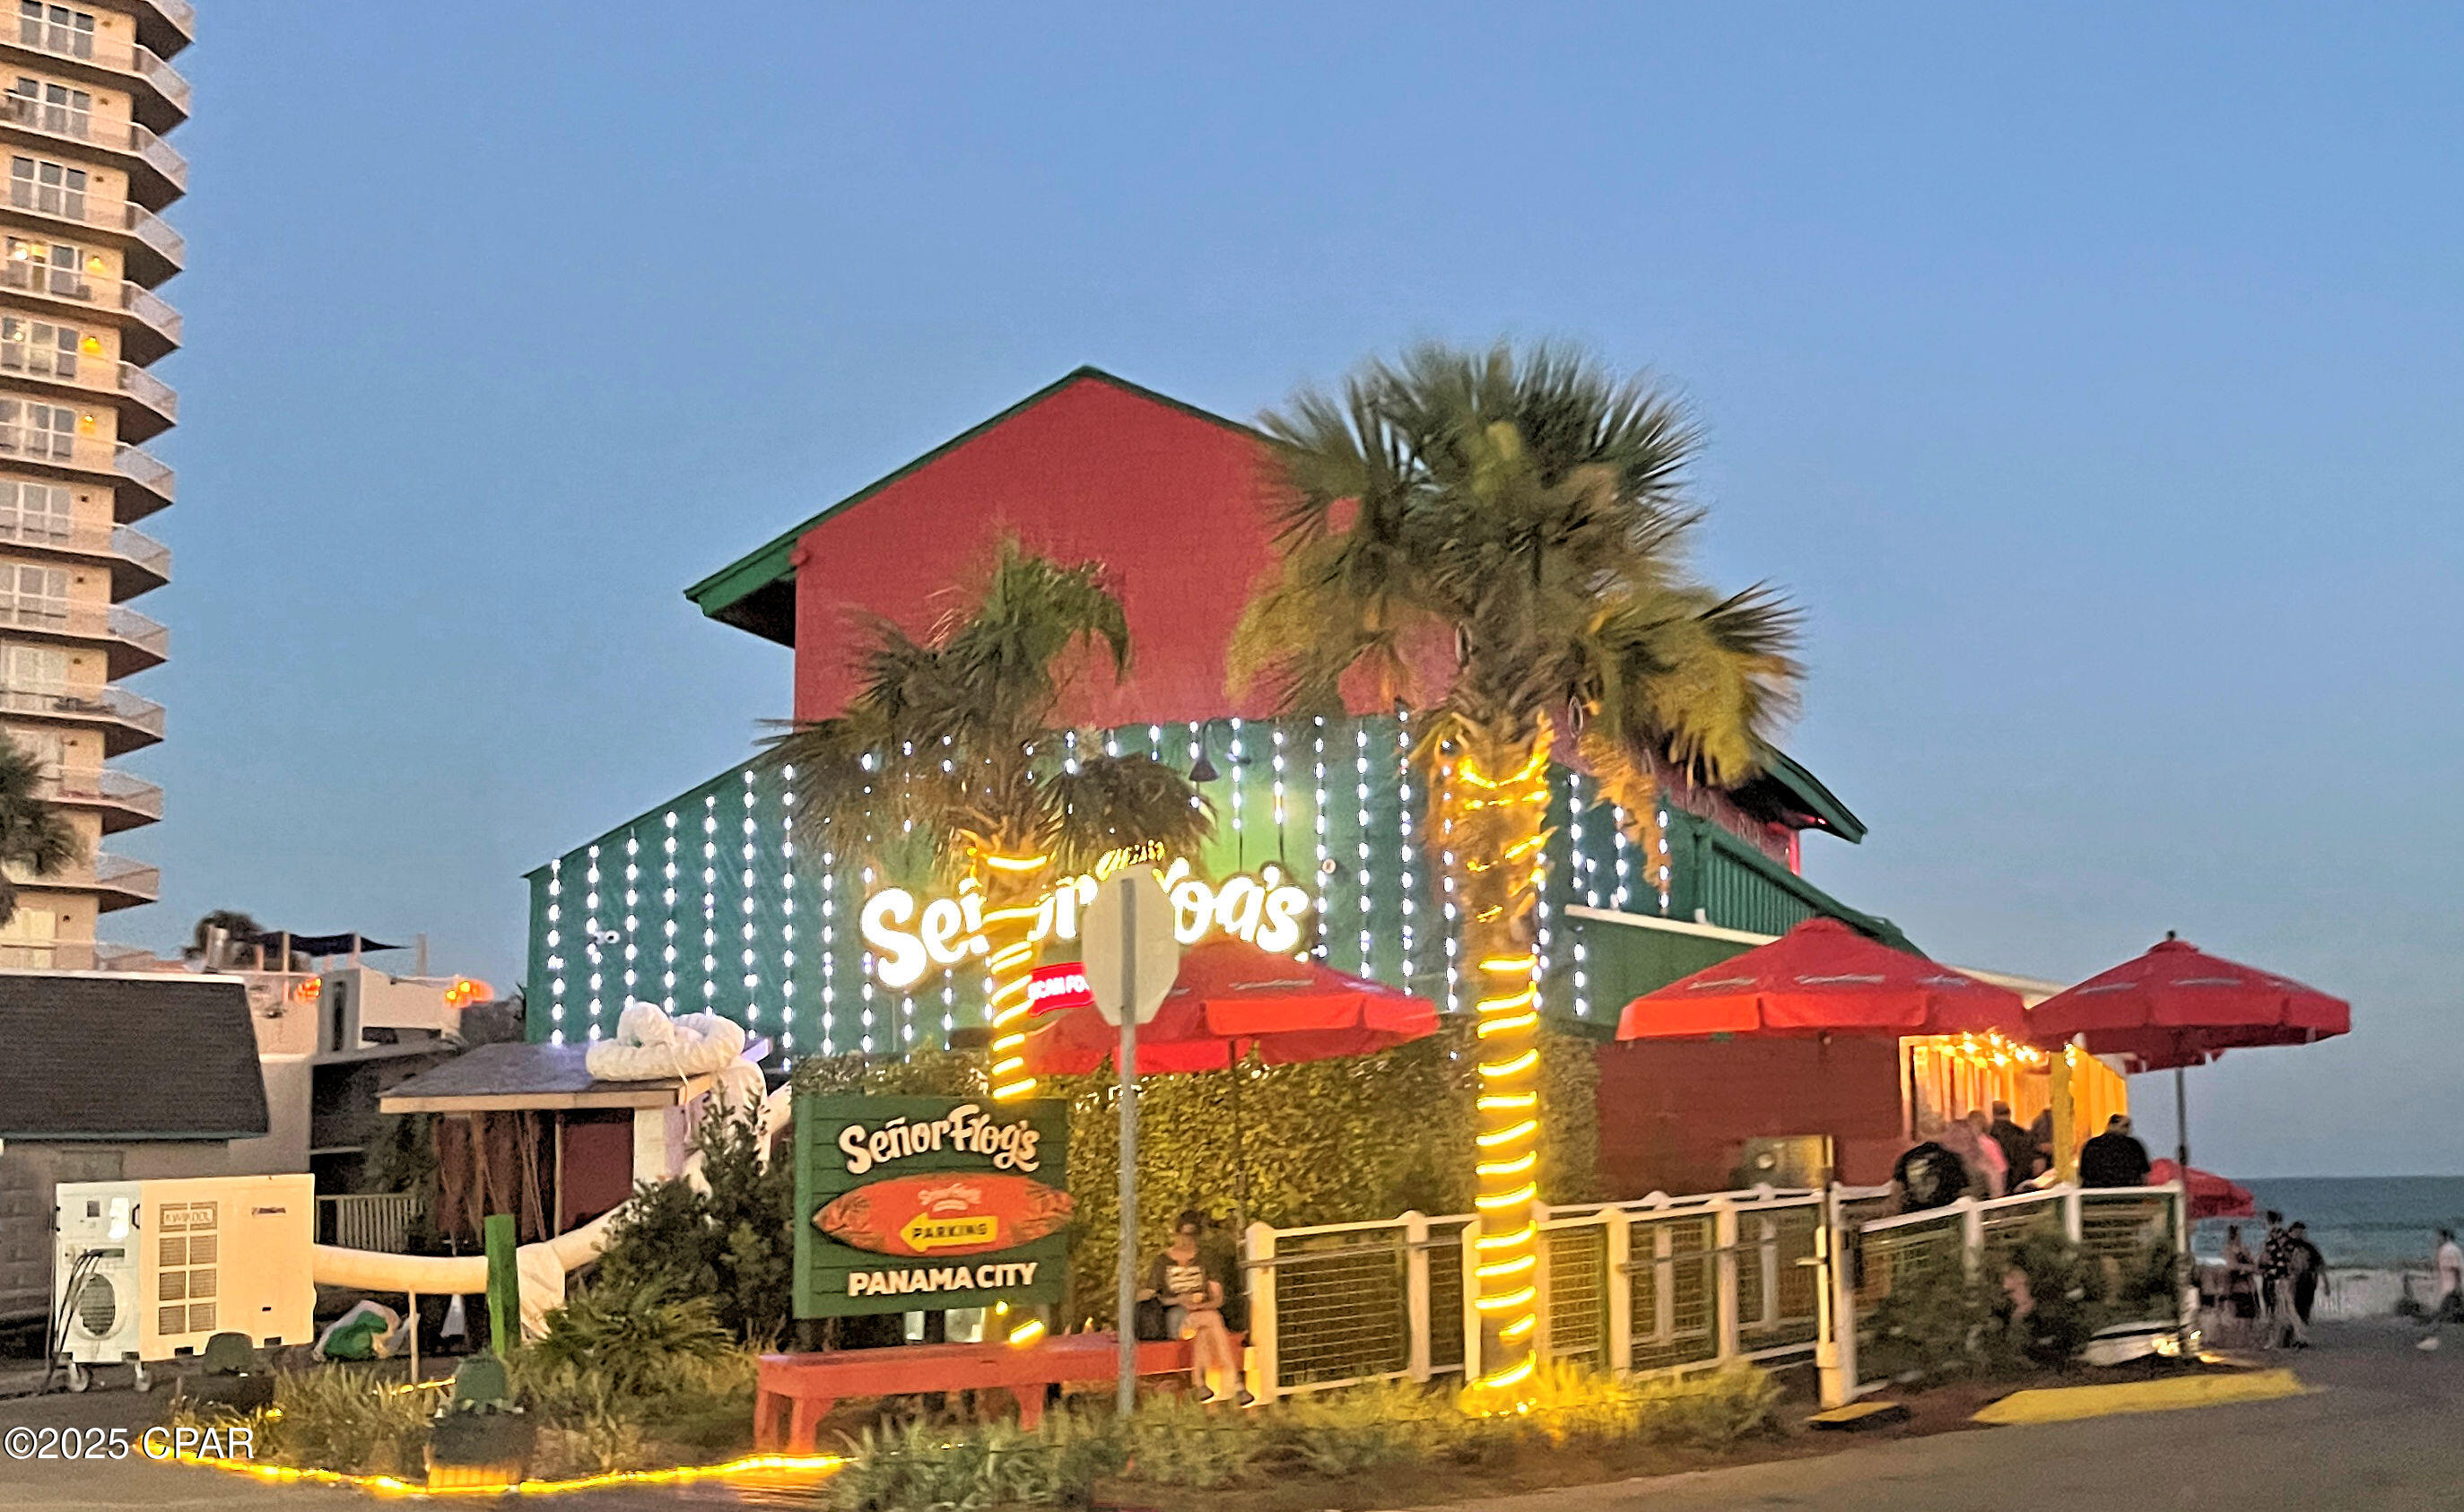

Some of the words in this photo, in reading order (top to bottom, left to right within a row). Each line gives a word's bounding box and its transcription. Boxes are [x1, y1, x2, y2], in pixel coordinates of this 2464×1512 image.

[912, 1222, 988, 1240] PARKING
[848, 1265, 973, 1297] PANAMA
[977, 1262, 1039, 1289] CITY
